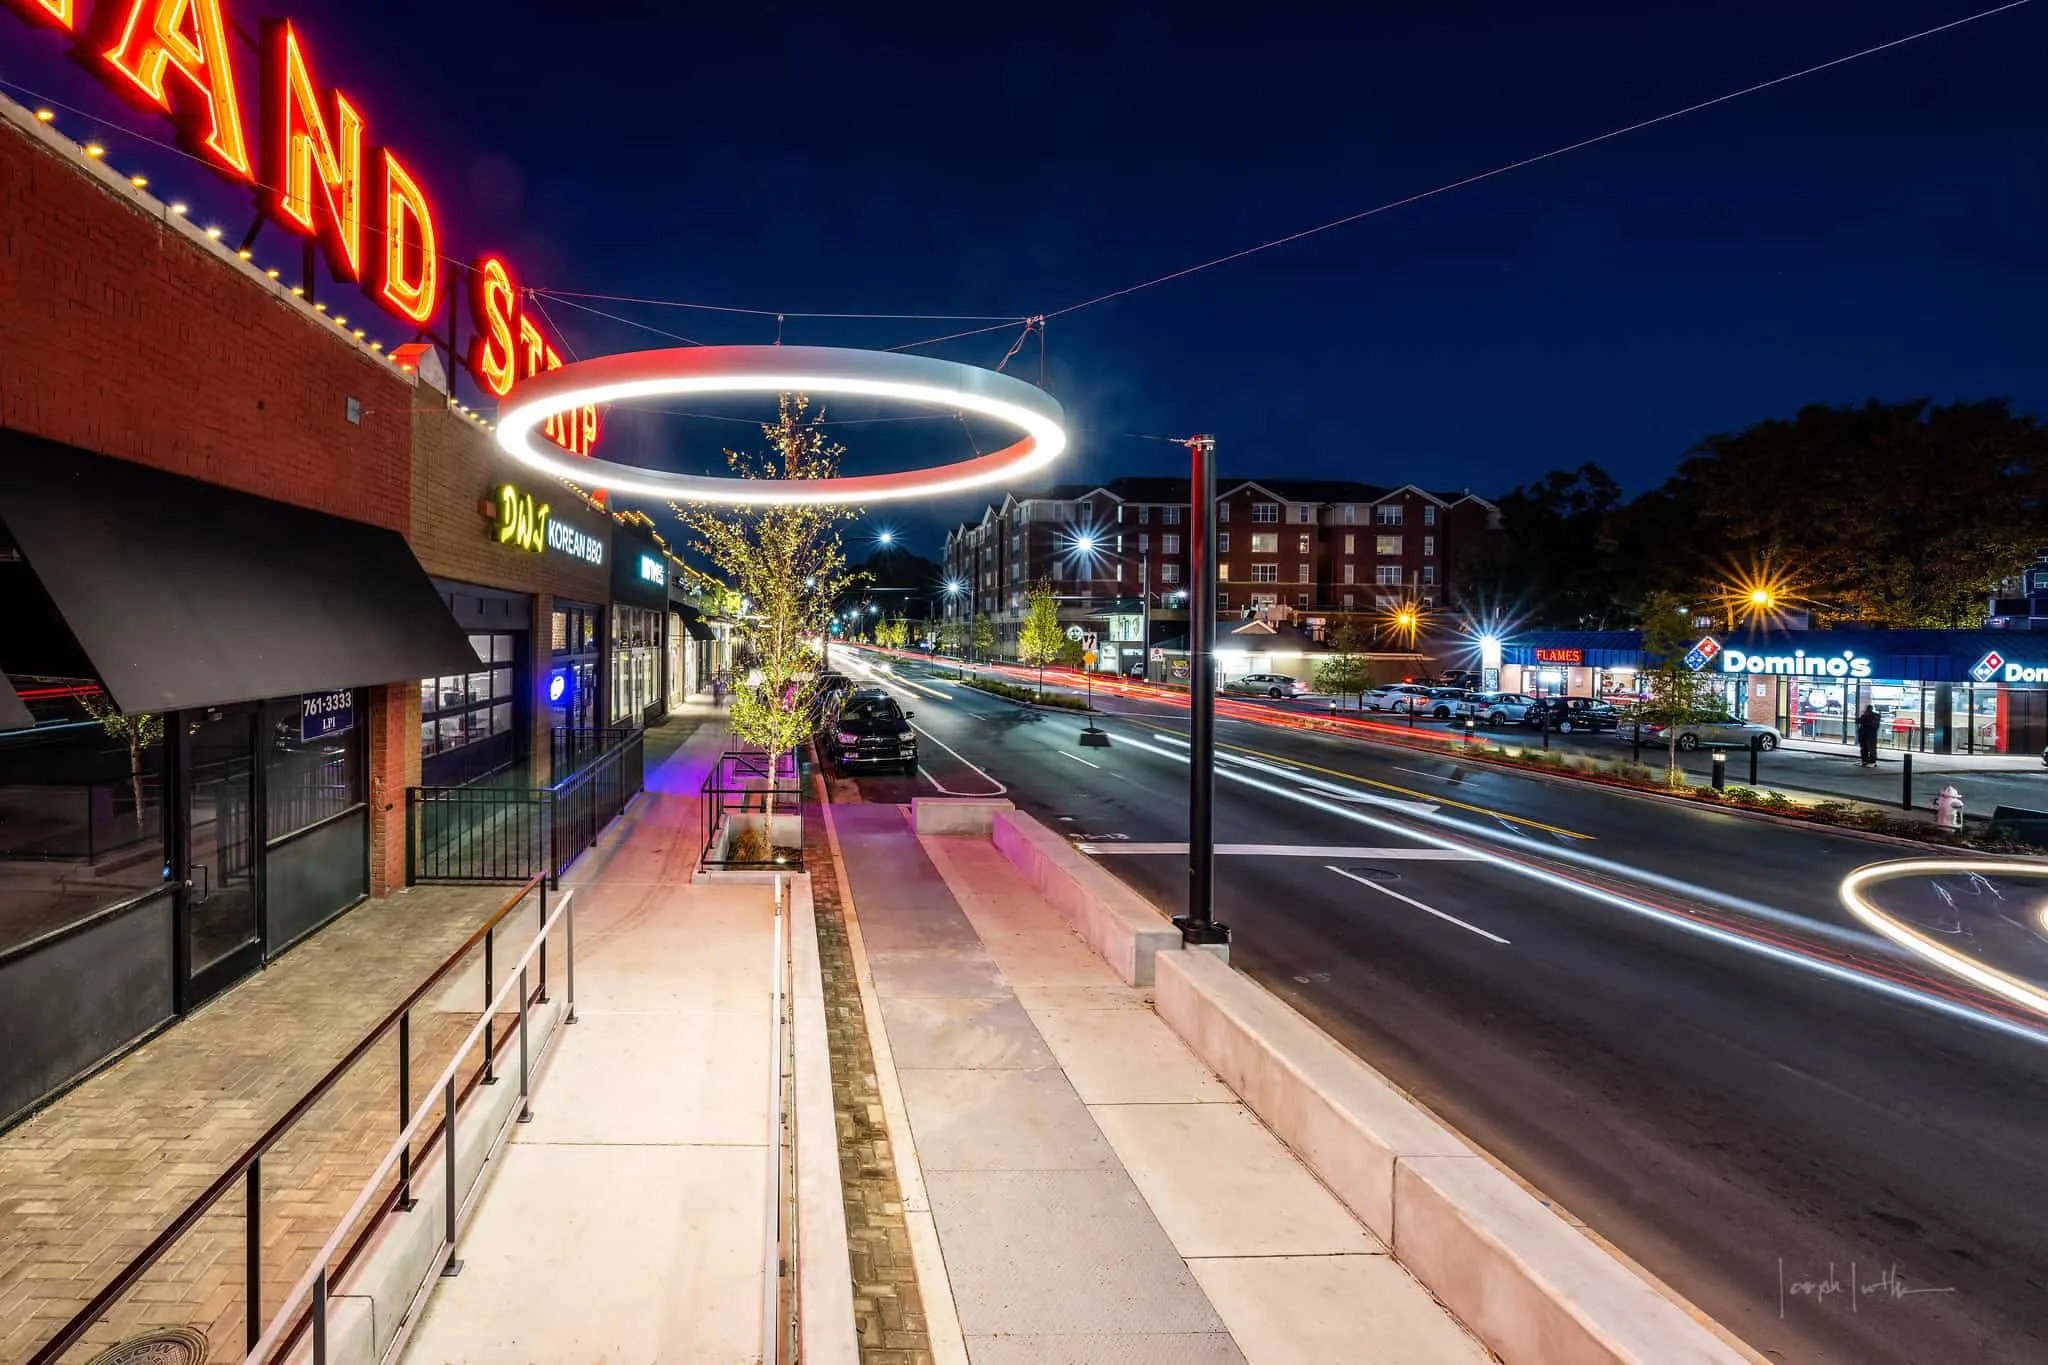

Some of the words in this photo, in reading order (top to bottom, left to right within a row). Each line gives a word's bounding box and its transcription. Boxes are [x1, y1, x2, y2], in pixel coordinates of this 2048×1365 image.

[35, 0, 438, 323] AND
[548, 519, 586, 559] KOREAN
[586, 537, 602, 565] BBQ
[1536, 649, 1580, 662] FLAMES
[1723, 649, 1872, 677] Domino's
